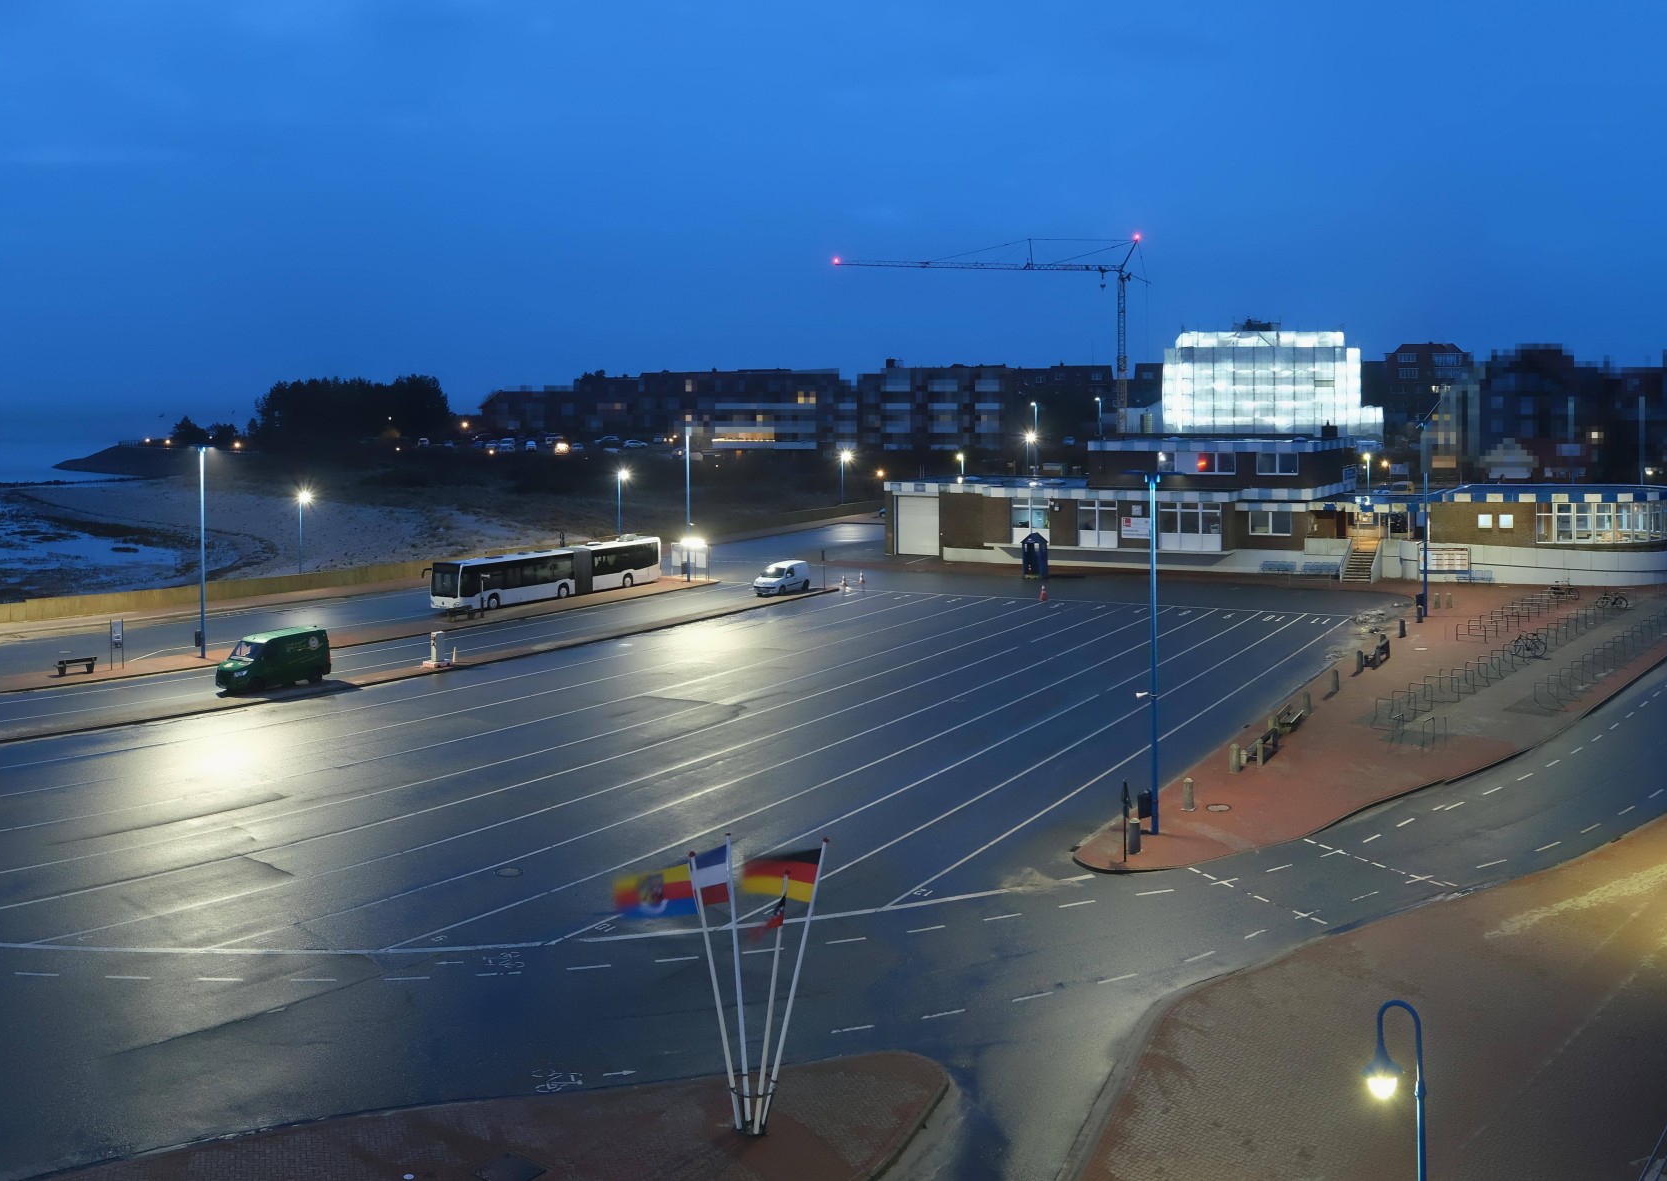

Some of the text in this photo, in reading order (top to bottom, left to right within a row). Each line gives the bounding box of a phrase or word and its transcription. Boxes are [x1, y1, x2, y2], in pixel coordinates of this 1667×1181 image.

[1310, 617, 1331, 625] 11
[913, 888, 933, 897] 12
[595, 923, 616, 932] 10
